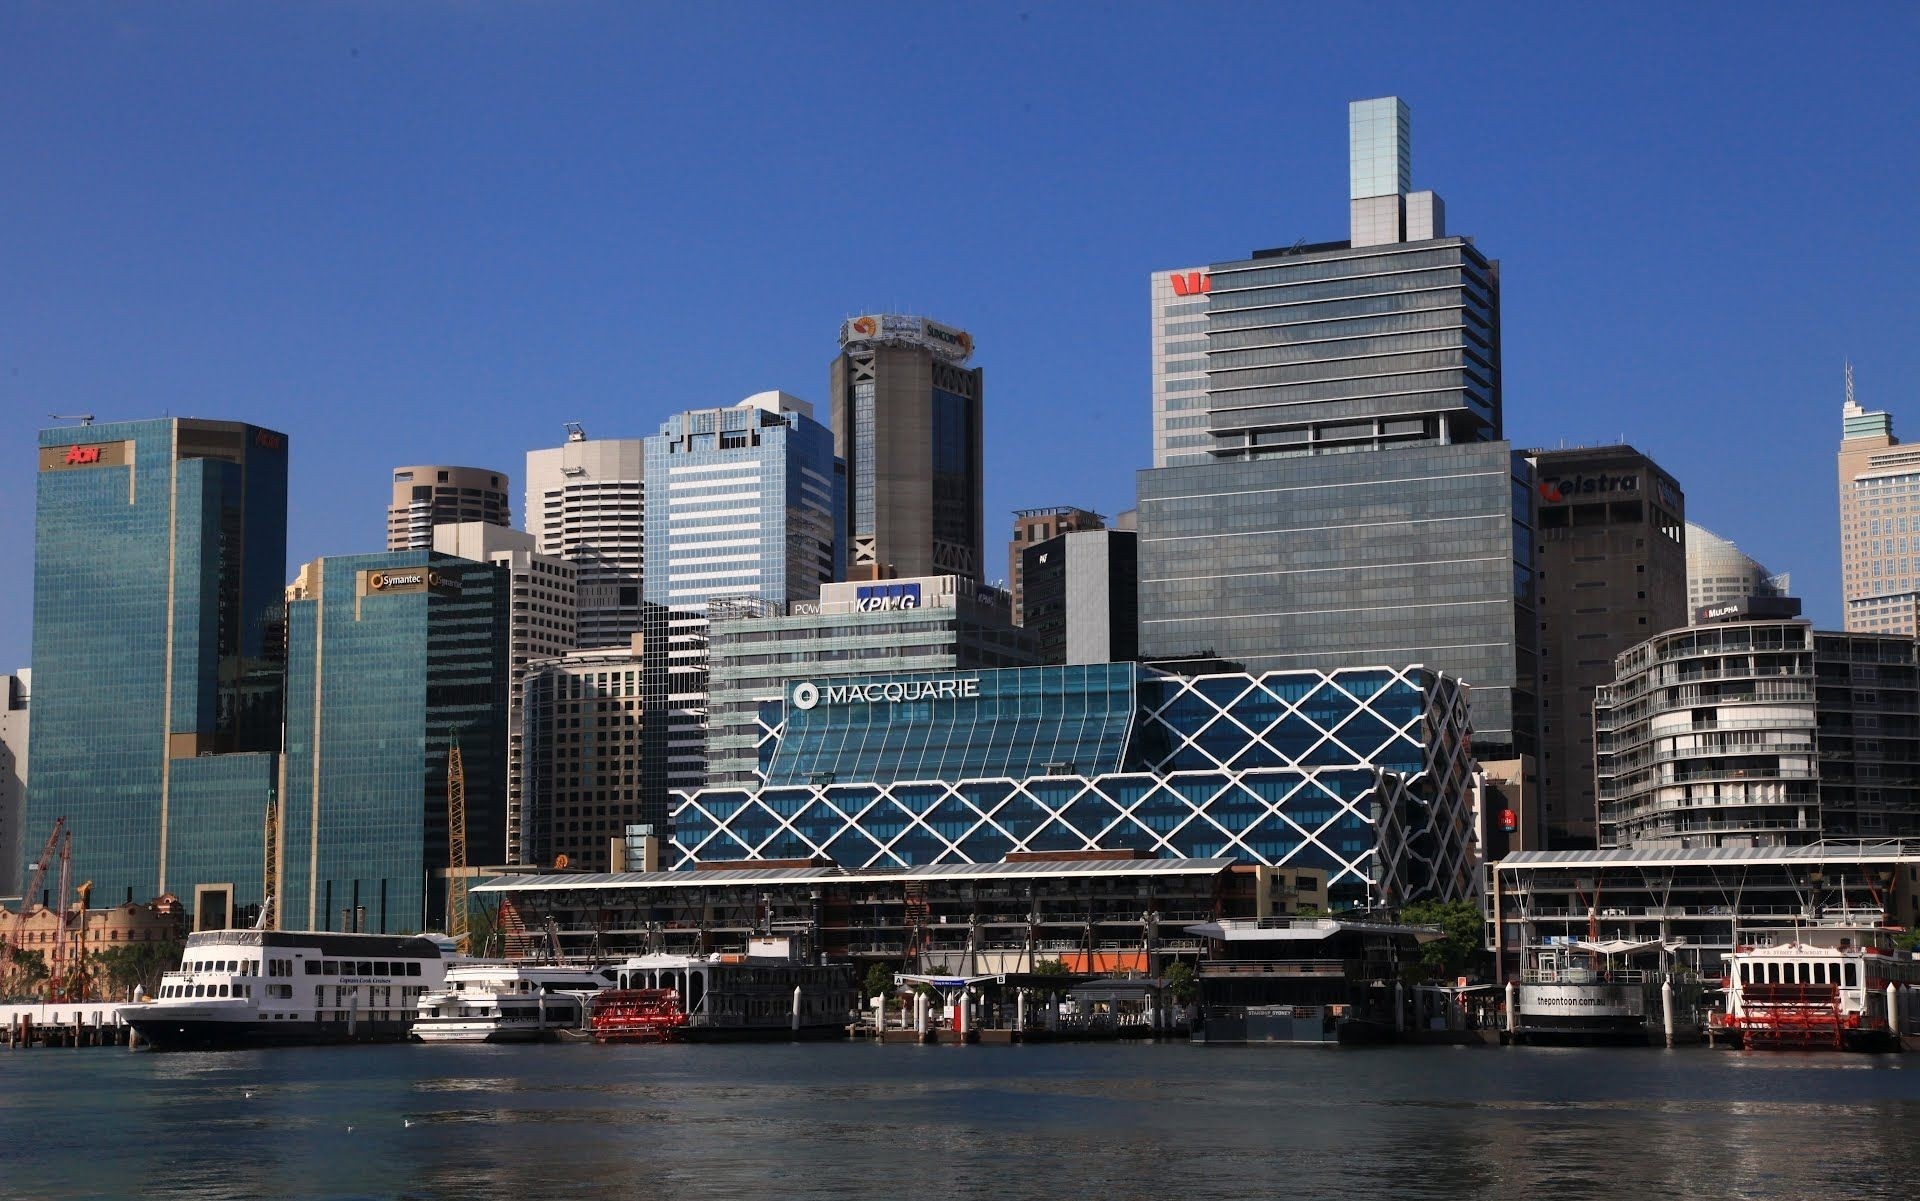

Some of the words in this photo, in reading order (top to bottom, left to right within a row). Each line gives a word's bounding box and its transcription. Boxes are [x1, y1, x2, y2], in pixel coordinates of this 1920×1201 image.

[383, 575, 421, 586] Symantec
[856, 594, 915, 612] KPMG
[1708, 605, 1738, 618] MULPHA
[827, 678, 980, 704] MACQUARIE
[1537, 996, 1606, 1006] thepontoon.com.au
